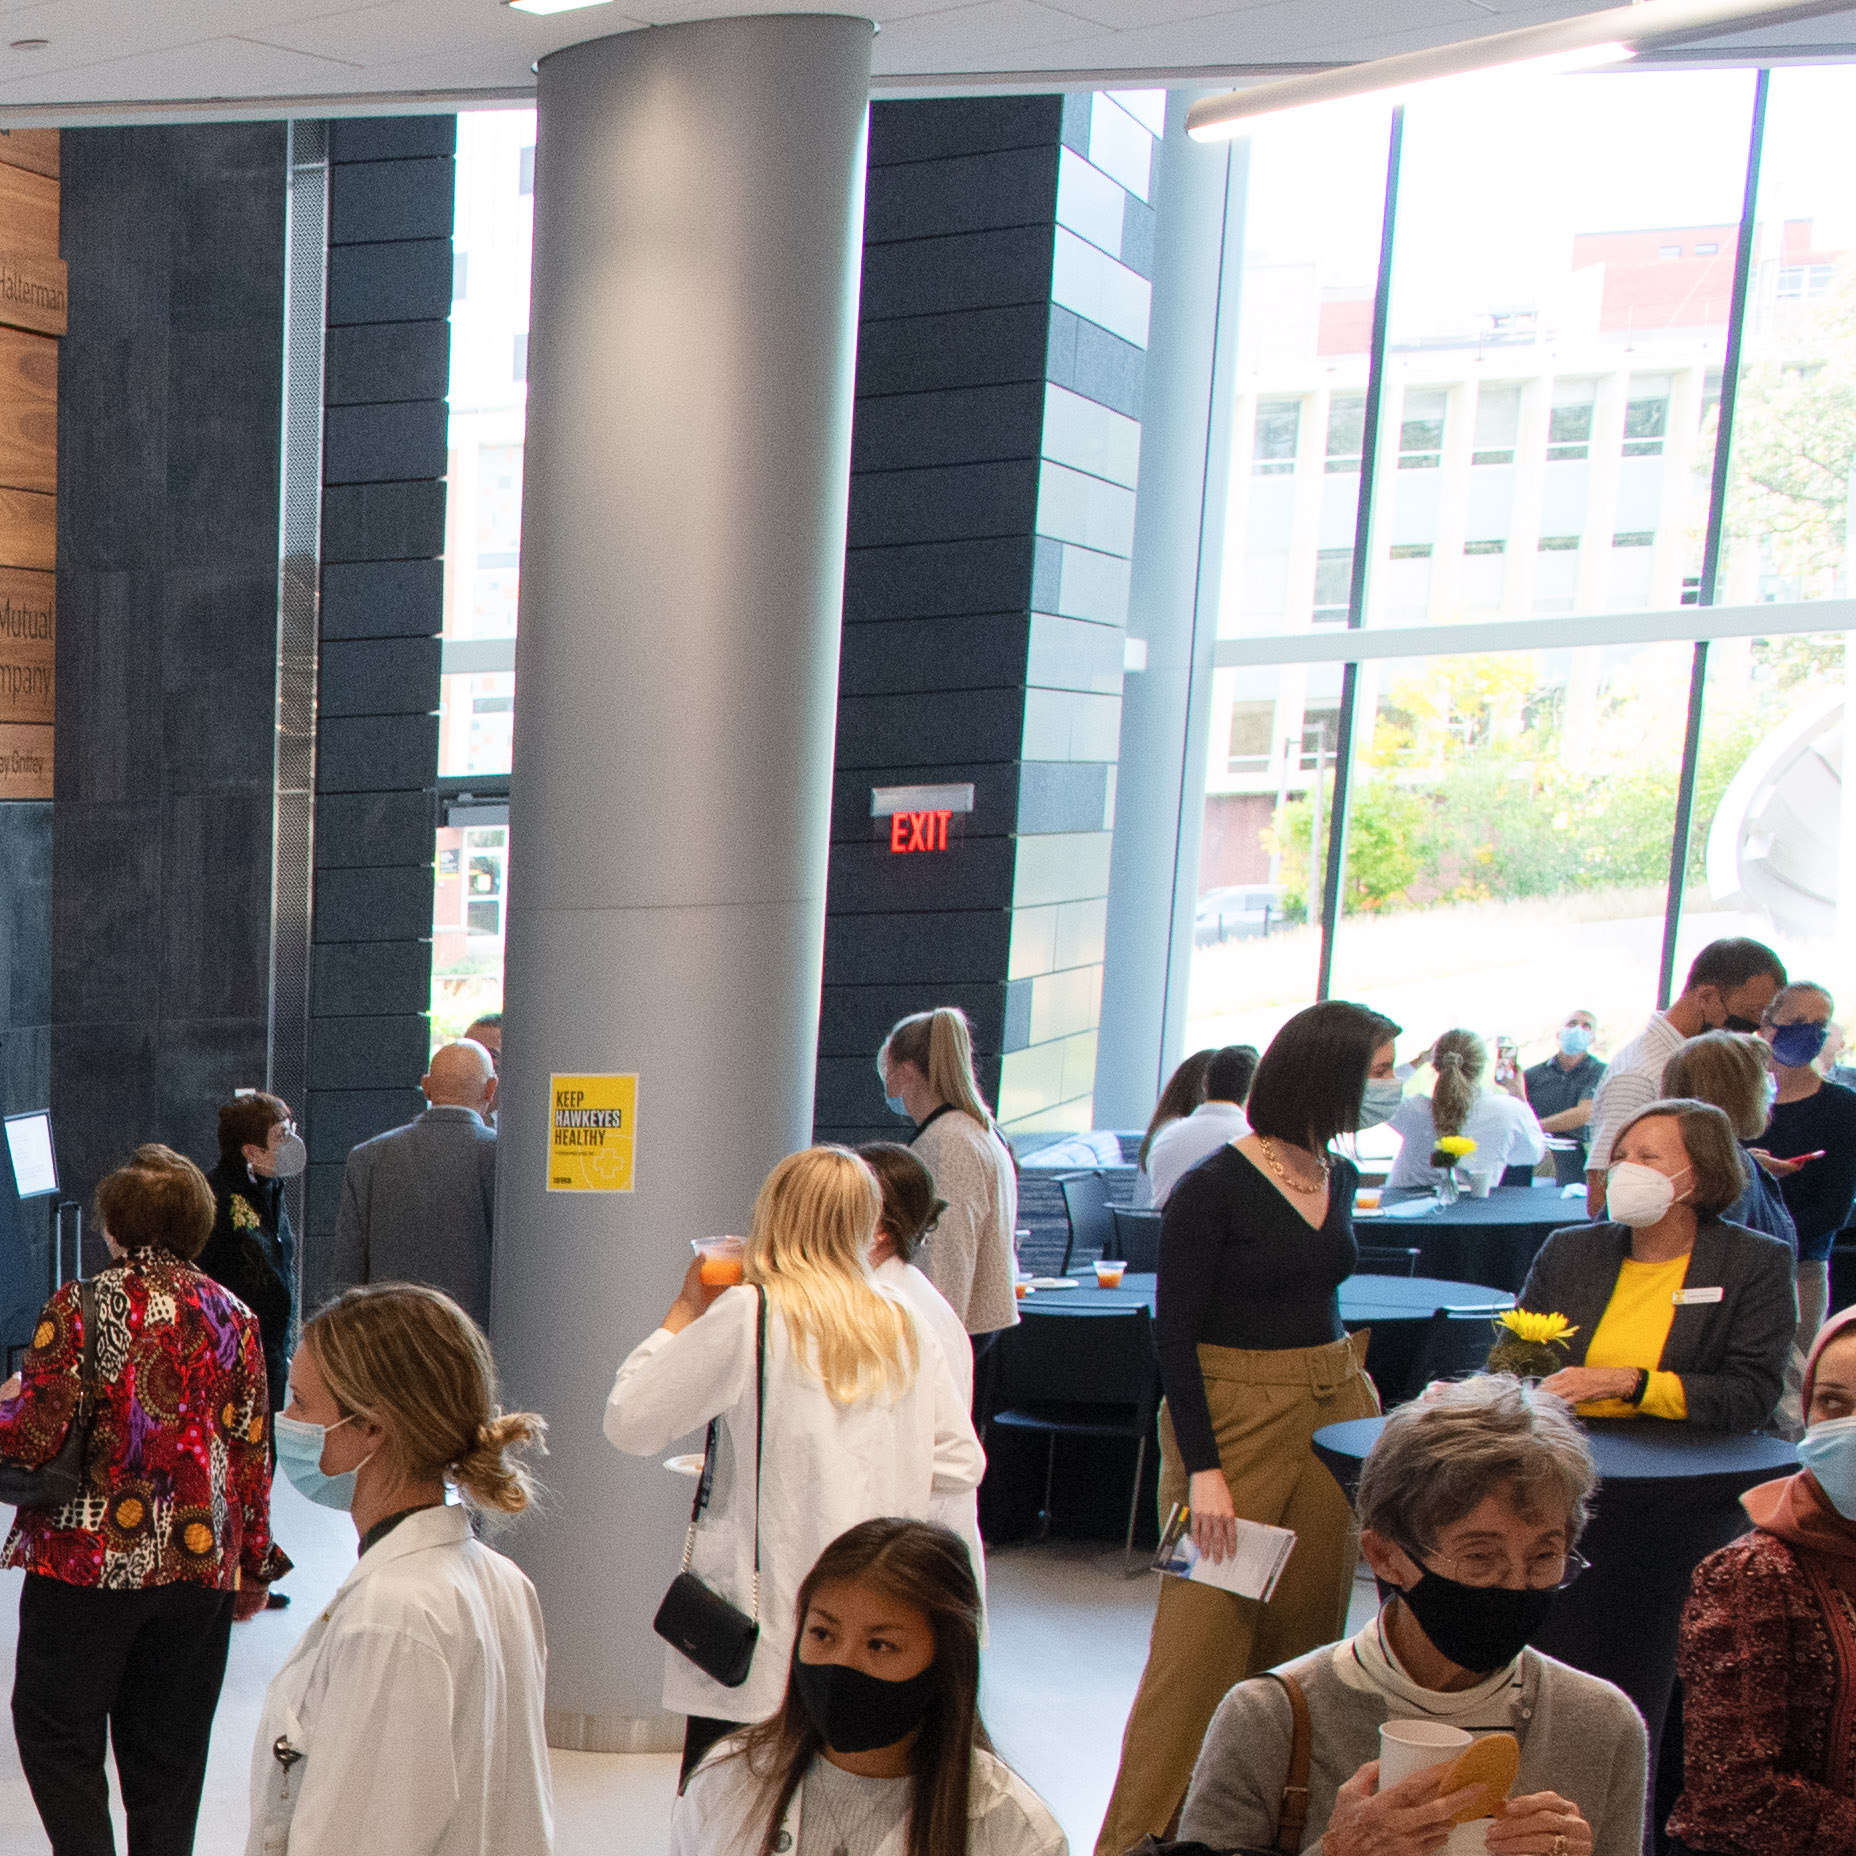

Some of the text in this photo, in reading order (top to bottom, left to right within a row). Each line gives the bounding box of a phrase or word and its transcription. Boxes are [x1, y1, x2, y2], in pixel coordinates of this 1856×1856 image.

[891, 809, 952, 853] EXIT
[556, 1091, 584, 1107] KEEP
[555, 1109, 620, 1127] HAWKEYES
[555, 1129, 606, 1145] HEALTHY
